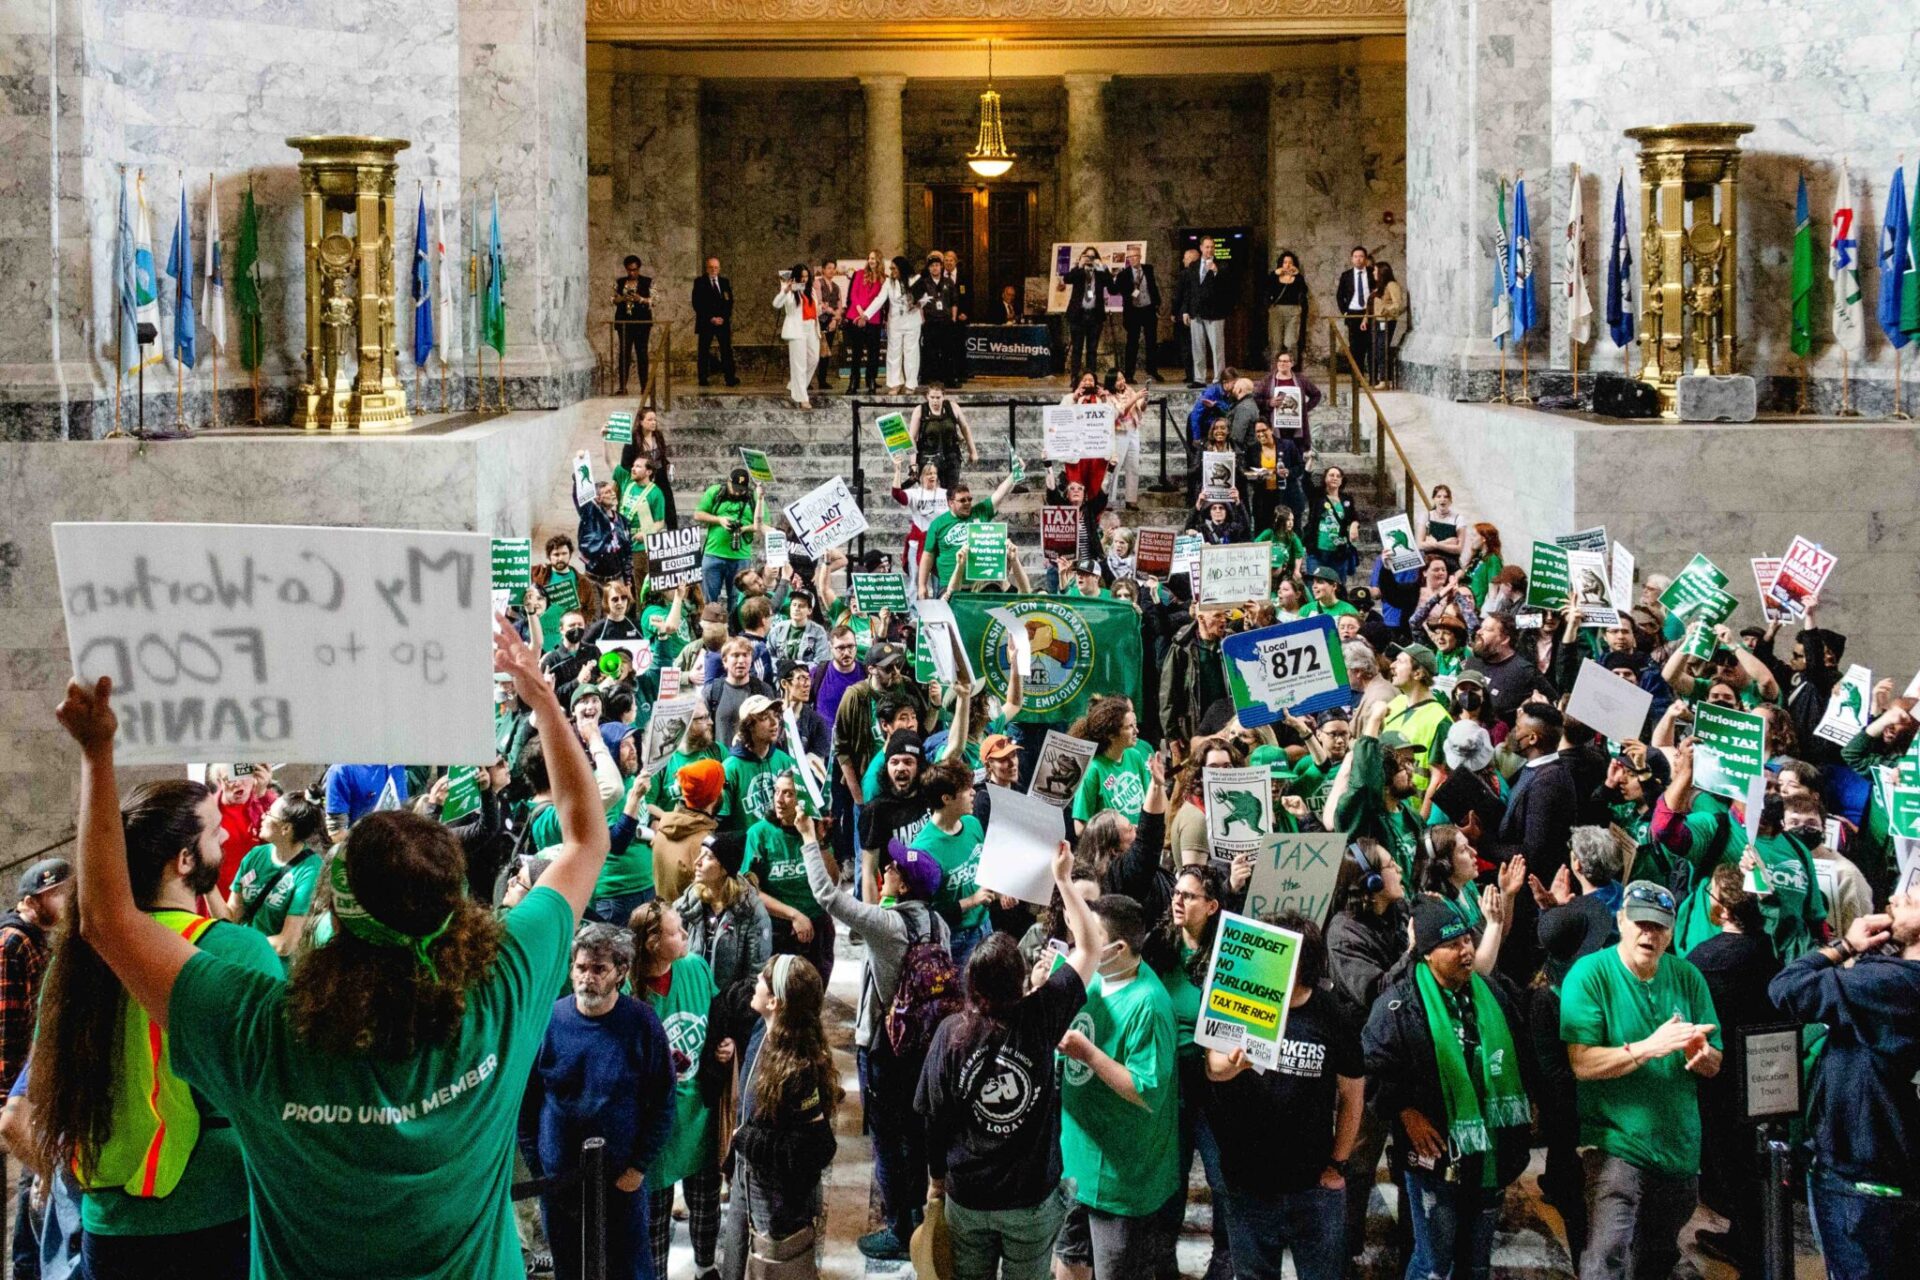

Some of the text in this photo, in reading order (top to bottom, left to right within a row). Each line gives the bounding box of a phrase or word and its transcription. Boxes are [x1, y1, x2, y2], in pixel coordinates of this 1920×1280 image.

[1085, 411, 1105, 419] TAX
[821, 503, 842, 526] NOT
[1044, 510, 1075, 525] TAX
[1044, 524, 1075, 533] AMAZON
[647, 526, 700, 551] UNION
[1140, 538, 1172, 547] $25/HOUR
[492, 544, 529, 552] Furloughs
[513, 556, 529, 564] TAX
[665, 557, 693, 569] EQUALS
[1554, 561, 1568, 571] TAX
[1796, 542, 1830, 577] TAX
[650, 567, 703, 591] HEALTHCARE
[1206, 564, 1261, 580] AND SO AM I
[1045, 602, 1091, 659] FEDERATION
[1263, 640, 1288, 653] Local
[1271, 645, 1321, 679] 872
[1035, 671, 1084, 708] EMPLOYEES
[1699, 710, 1761, 732] Furloughs
[1698, 730, 1759, 750] are a TAX
[1717, 748, 1758, 766] Public
[1111, 778, 1142, 811] UNION
[1268, 839, 1330, 872] TAX
[768, 862, 807, 878] AFSC
[1281, 876, 1302, 893] the
[1223, 926, 1289, 956] NO BUDGET
[1220, 941, 1253, 961] CUTS!
[1216, 957, 1234, 972] NO
[1213, 972, 1285, 1004] FURLOUGHS!
[1213, 994, 1277, 1023] TAX THE RICH!
[1204, 1019, 1245, 1038] WORKERS
[1246, 1038, 1266, 1050] FIGHT
[1281, 1039, 1326, 1061] RKERS
[1781, 1043, 1792, 1055] for
[1013, 1050, 1034, 1069] UNION
[1255, 1049, 1272, 1061] RICH
[1298, 1057, 1323, 1070] BACK
[1752, 1072, 1789, 1083] Education
[282, 1053, 499, 1125] PROUD UNION MEMBER
[1761, 1086, 1782, 1096] Tours
